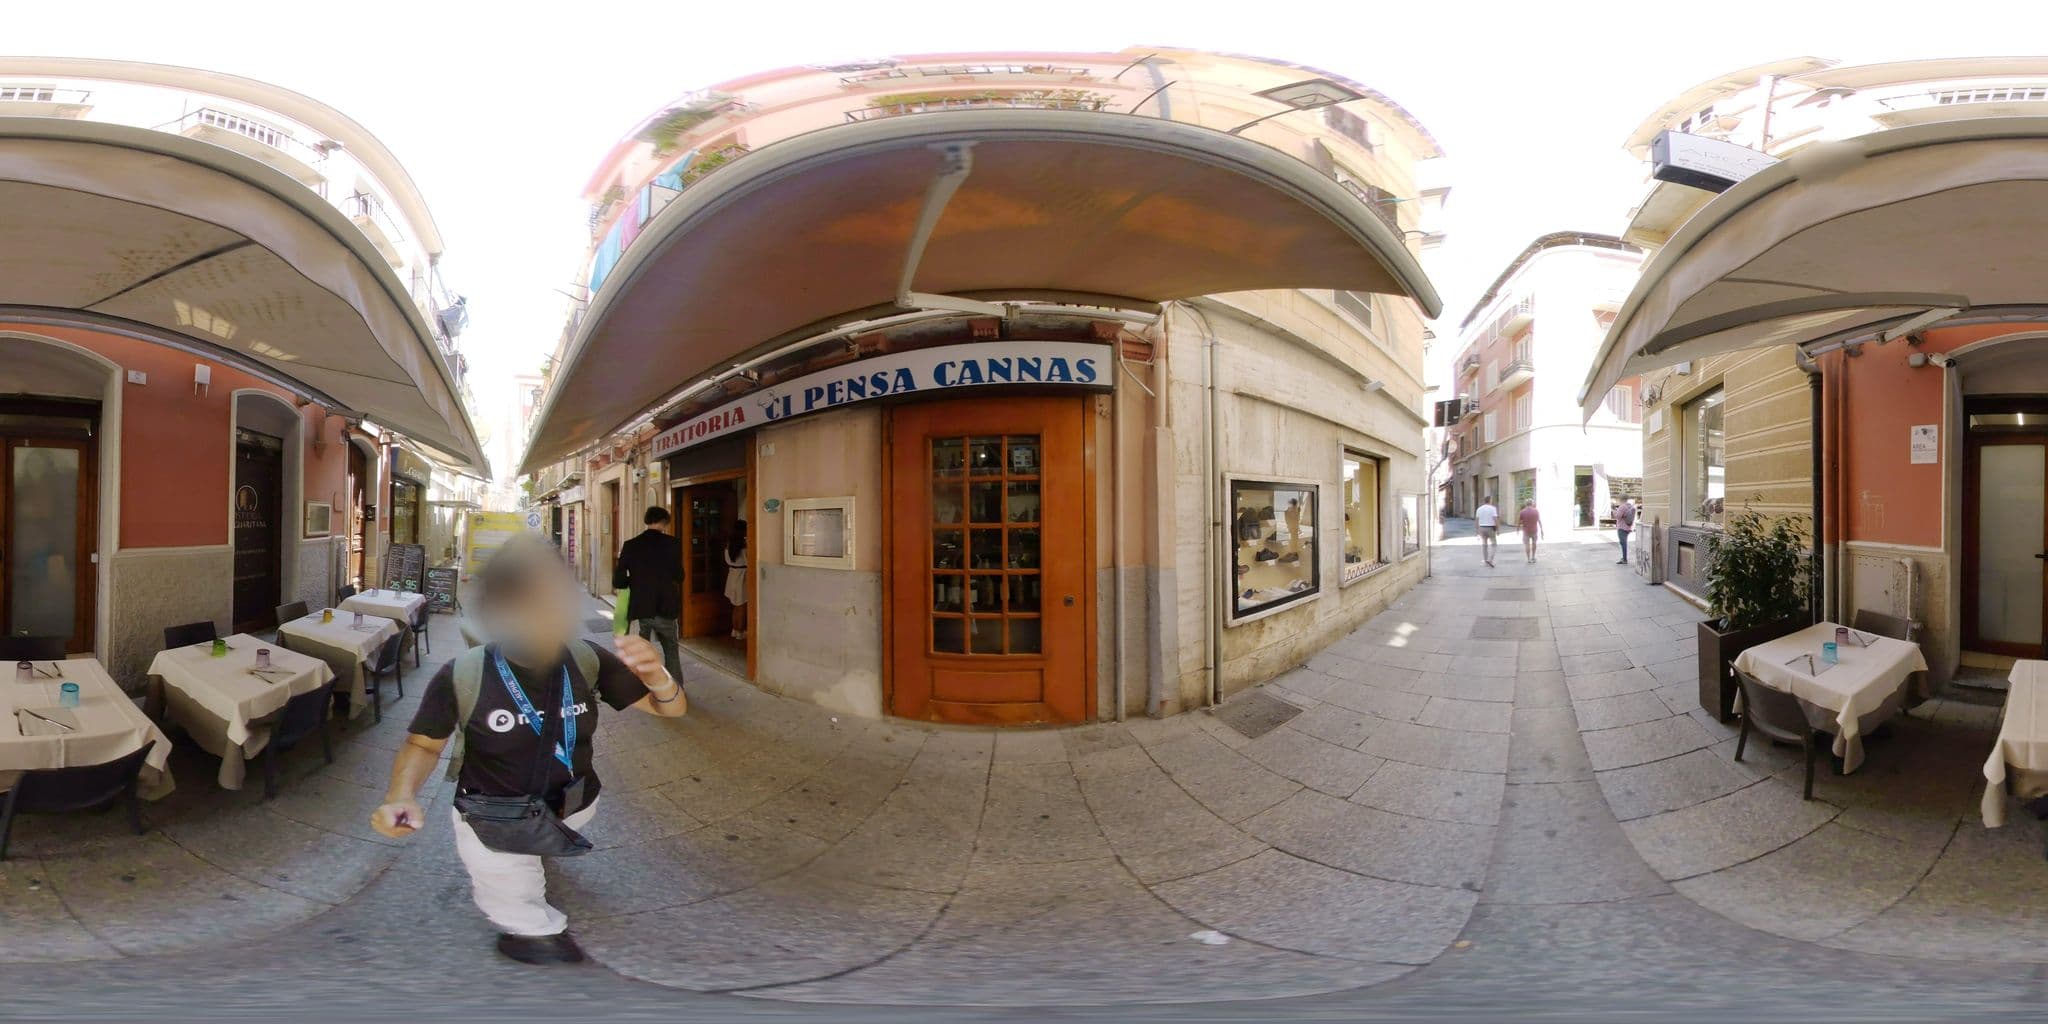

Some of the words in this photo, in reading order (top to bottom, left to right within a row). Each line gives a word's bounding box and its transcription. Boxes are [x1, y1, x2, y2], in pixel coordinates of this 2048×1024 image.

[656, 406, 746, 453] TRATTORIA
[764, 395, 793, 420] CI
[804, 367, 918, 411] PENSA
[933, 357, 1097, 387] CANNAS
